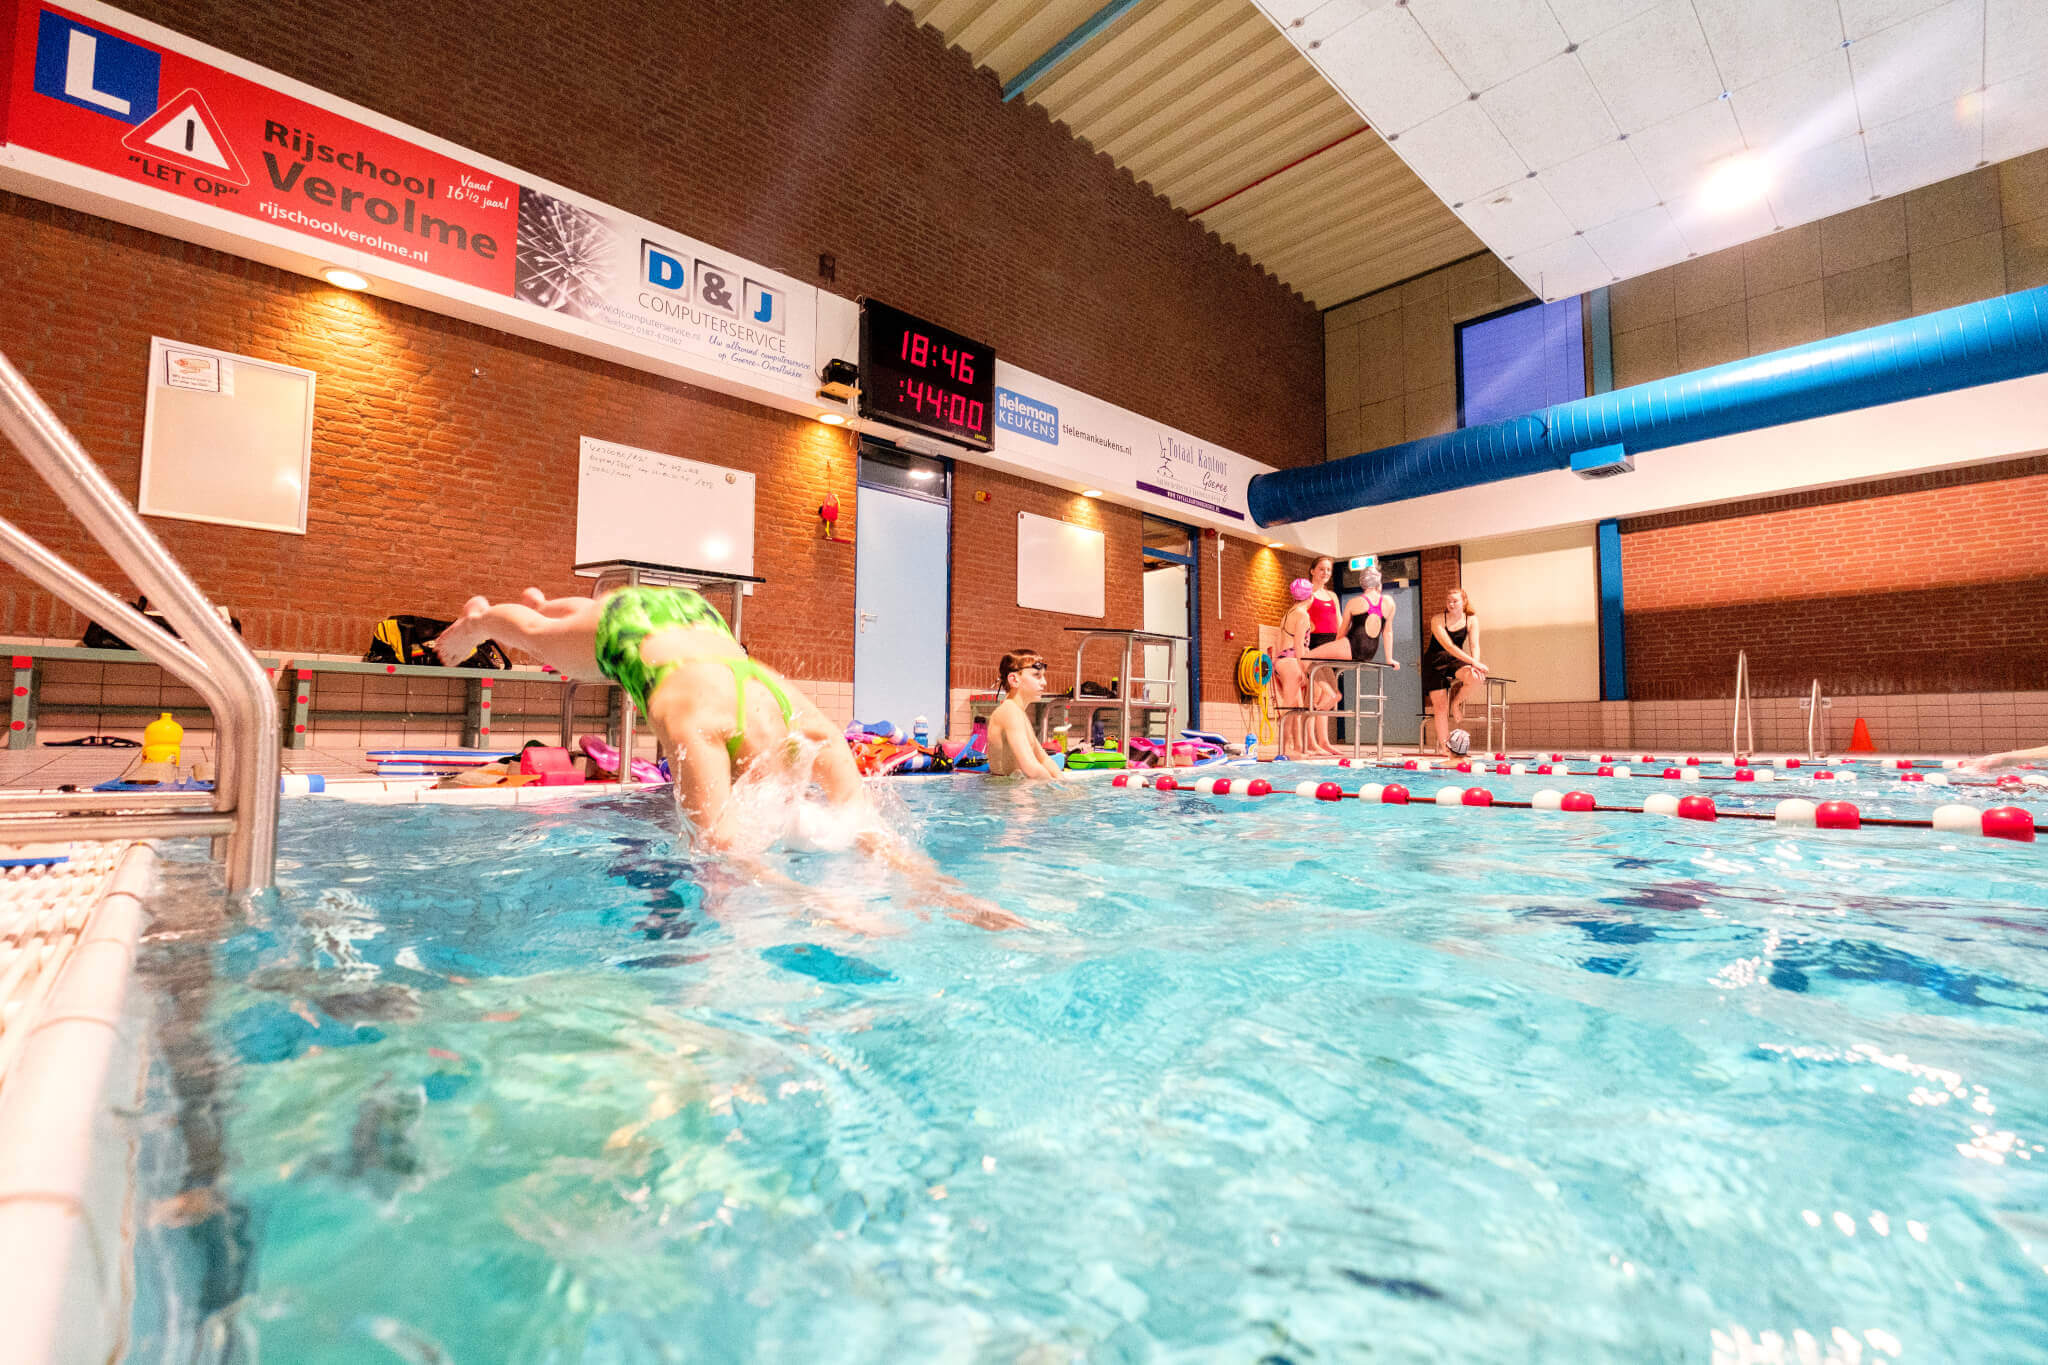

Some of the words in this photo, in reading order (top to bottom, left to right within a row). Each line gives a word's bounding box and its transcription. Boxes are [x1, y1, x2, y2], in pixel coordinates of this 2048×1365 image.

[65, 28, 131, 116] L
[264, 119, 436, 200] Rijschool
[460, 174, 494, 192] Vanaf
[262, 151, 499, 260] Verolme
[480, 196, 509, 210] jaar!
[259, 200, 429, 264] rijschoolverolme.nl
[649, 248, 685, 290] D
[753, 291, 773, 323] J
[637, 292, 787, 354] COMPUTERSERVICE
[901, 330, 975, 385] 18:46
[998, 392, 1056, 425] tieleman
[998, 409, 1056, 439] KEUKENS
[1062, 423, 1132, 456] tielemankeukens.nl
[1167, 436, 1194, 465] Totaal
[1198, 447, 1228, 477] Kantoor
